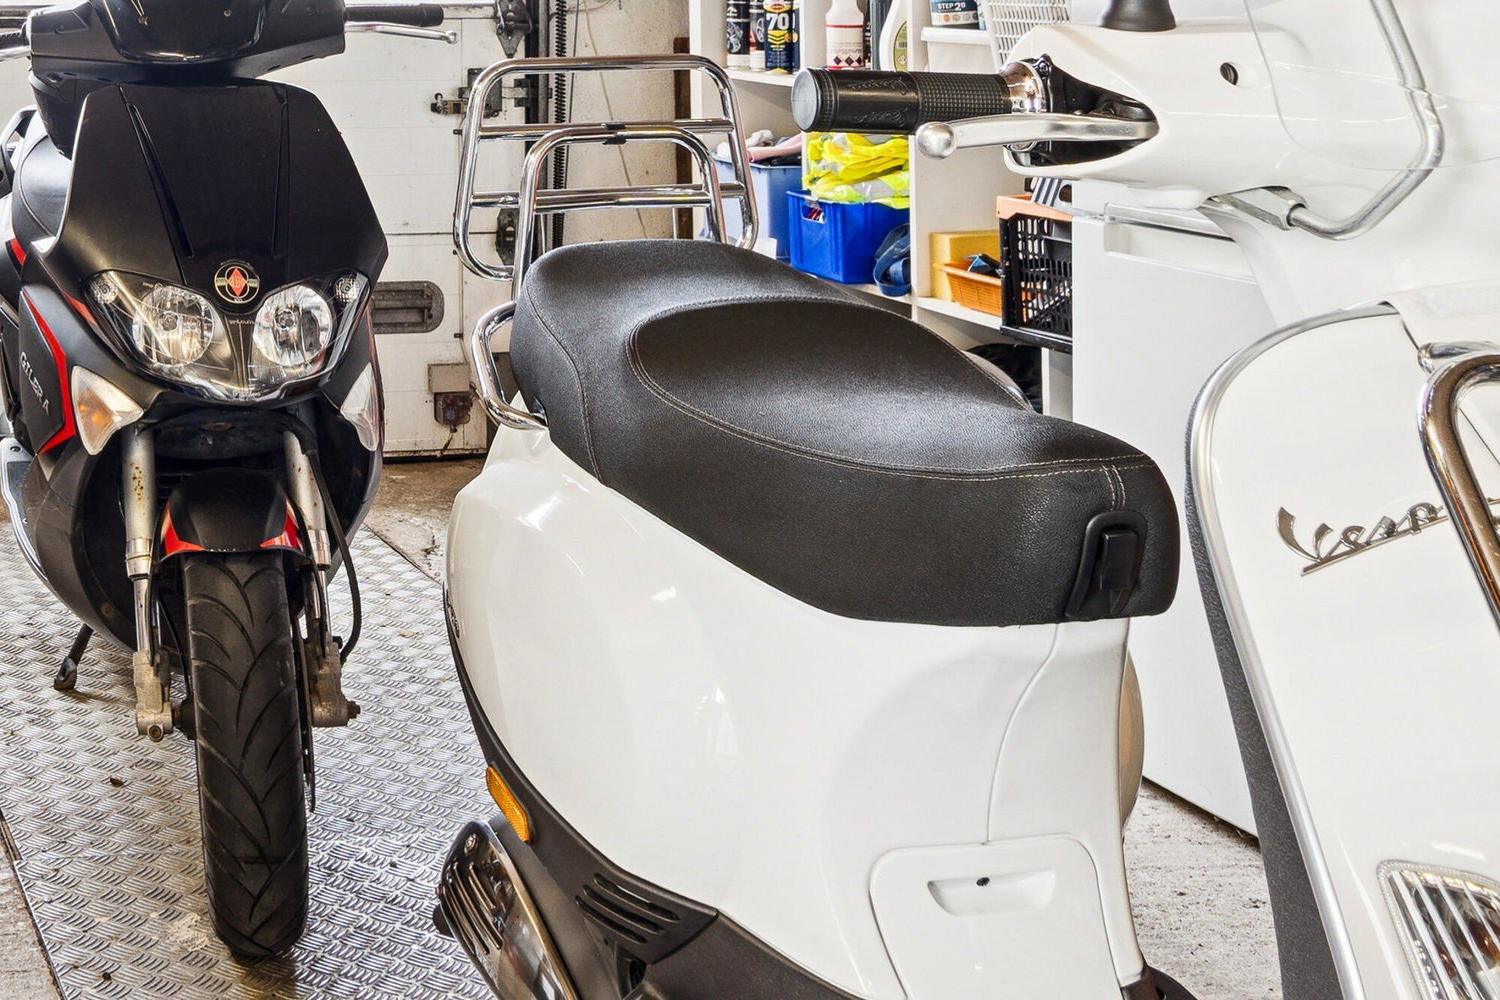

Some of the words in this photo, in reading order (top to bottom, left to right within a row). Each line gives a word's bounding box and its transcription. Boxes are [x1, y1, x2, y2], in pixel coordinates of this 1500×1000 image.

[766, 13, 790, 30] 70
[20, 351, 50, 416] GILERA
[1275, 502, 1449, 577] Vesp
